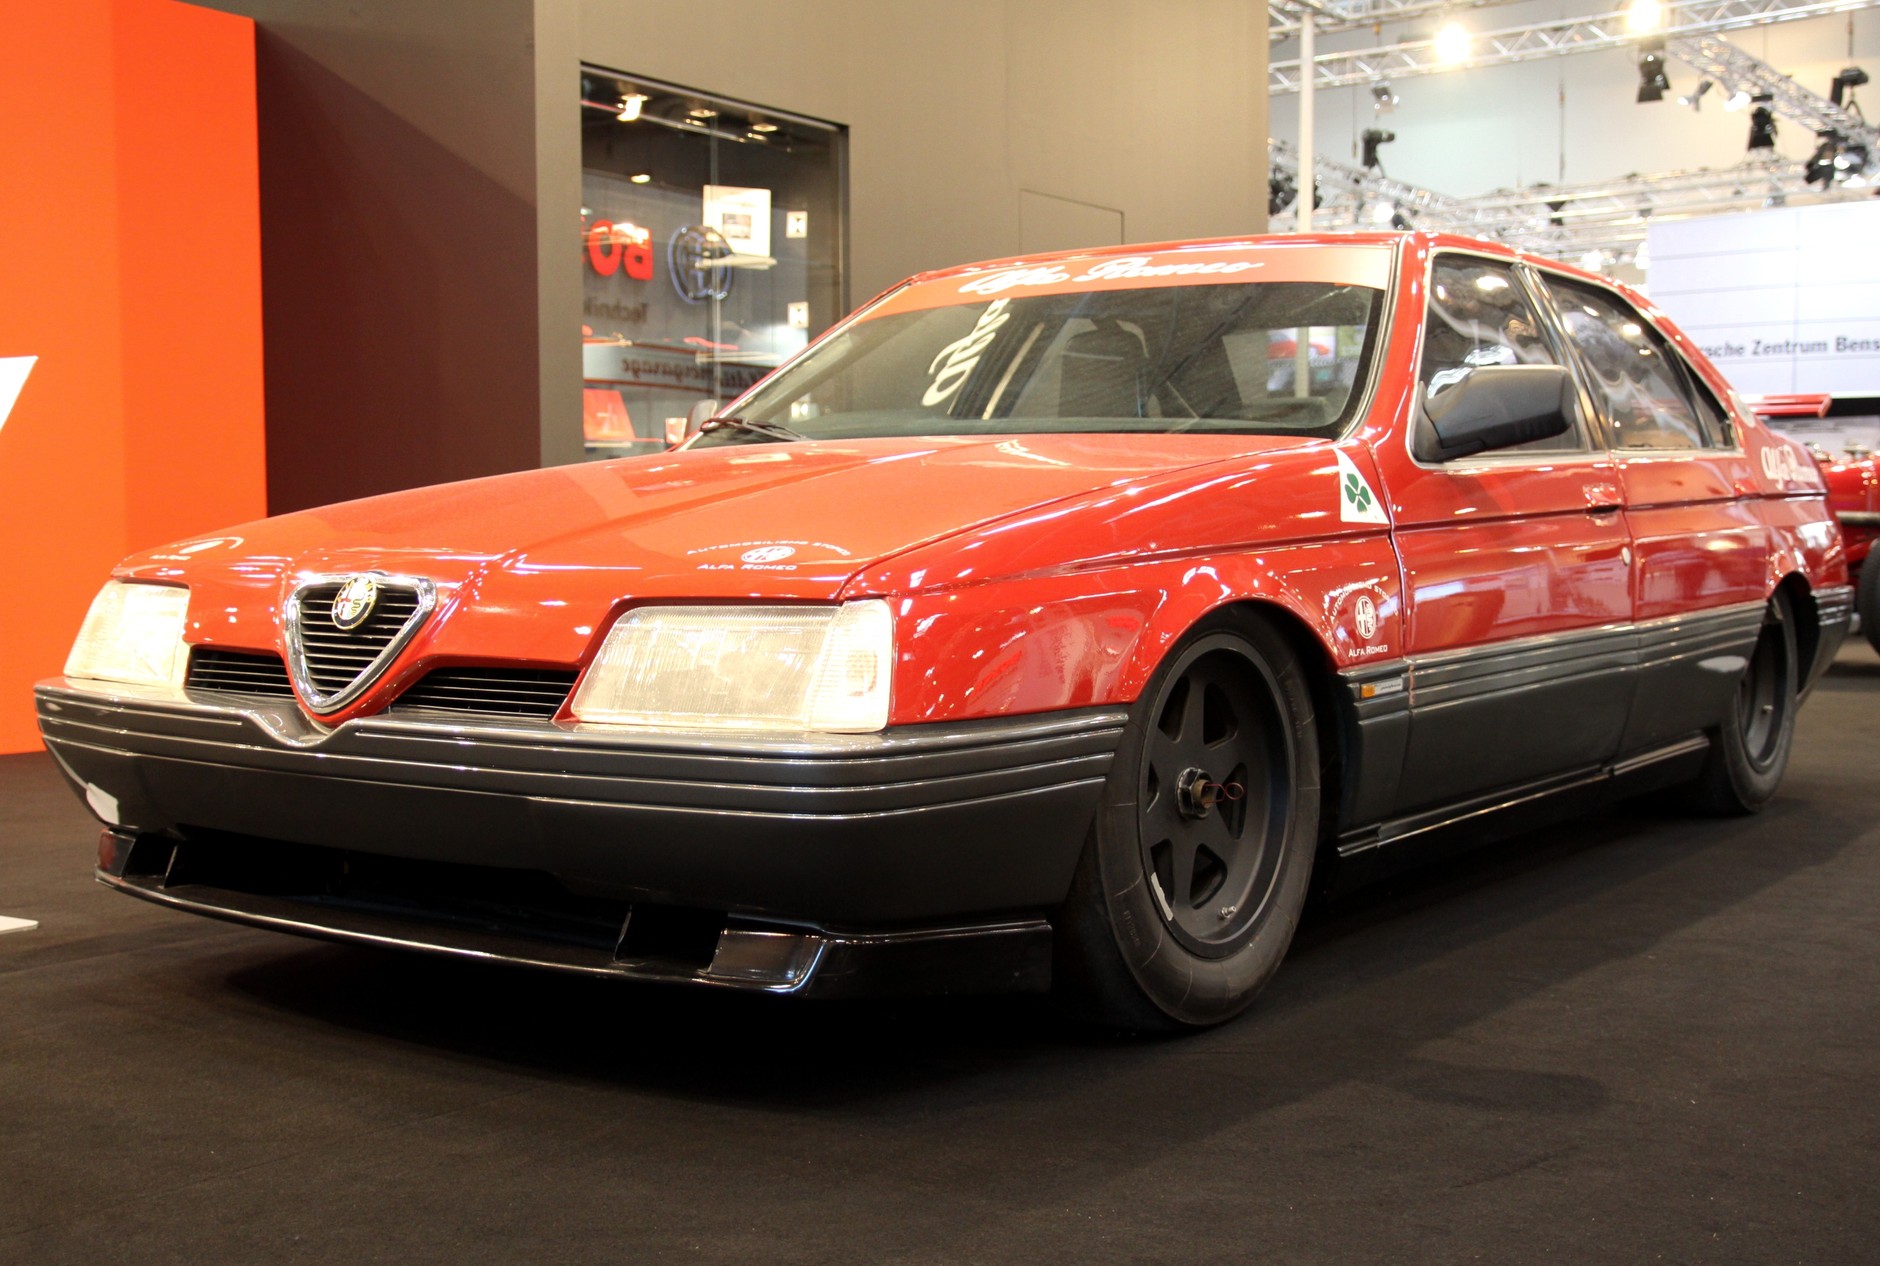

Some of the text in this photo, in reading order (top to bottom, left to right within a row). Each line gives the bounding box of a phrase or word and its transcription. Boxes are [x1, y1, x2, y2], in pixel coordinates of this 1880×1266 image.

[958, 257, 1265, 295] Alfa Romeo
[1752, 339, 1828, 356] Zentrum
[1348, 644, 1388, 658] ALFA ROMEO
